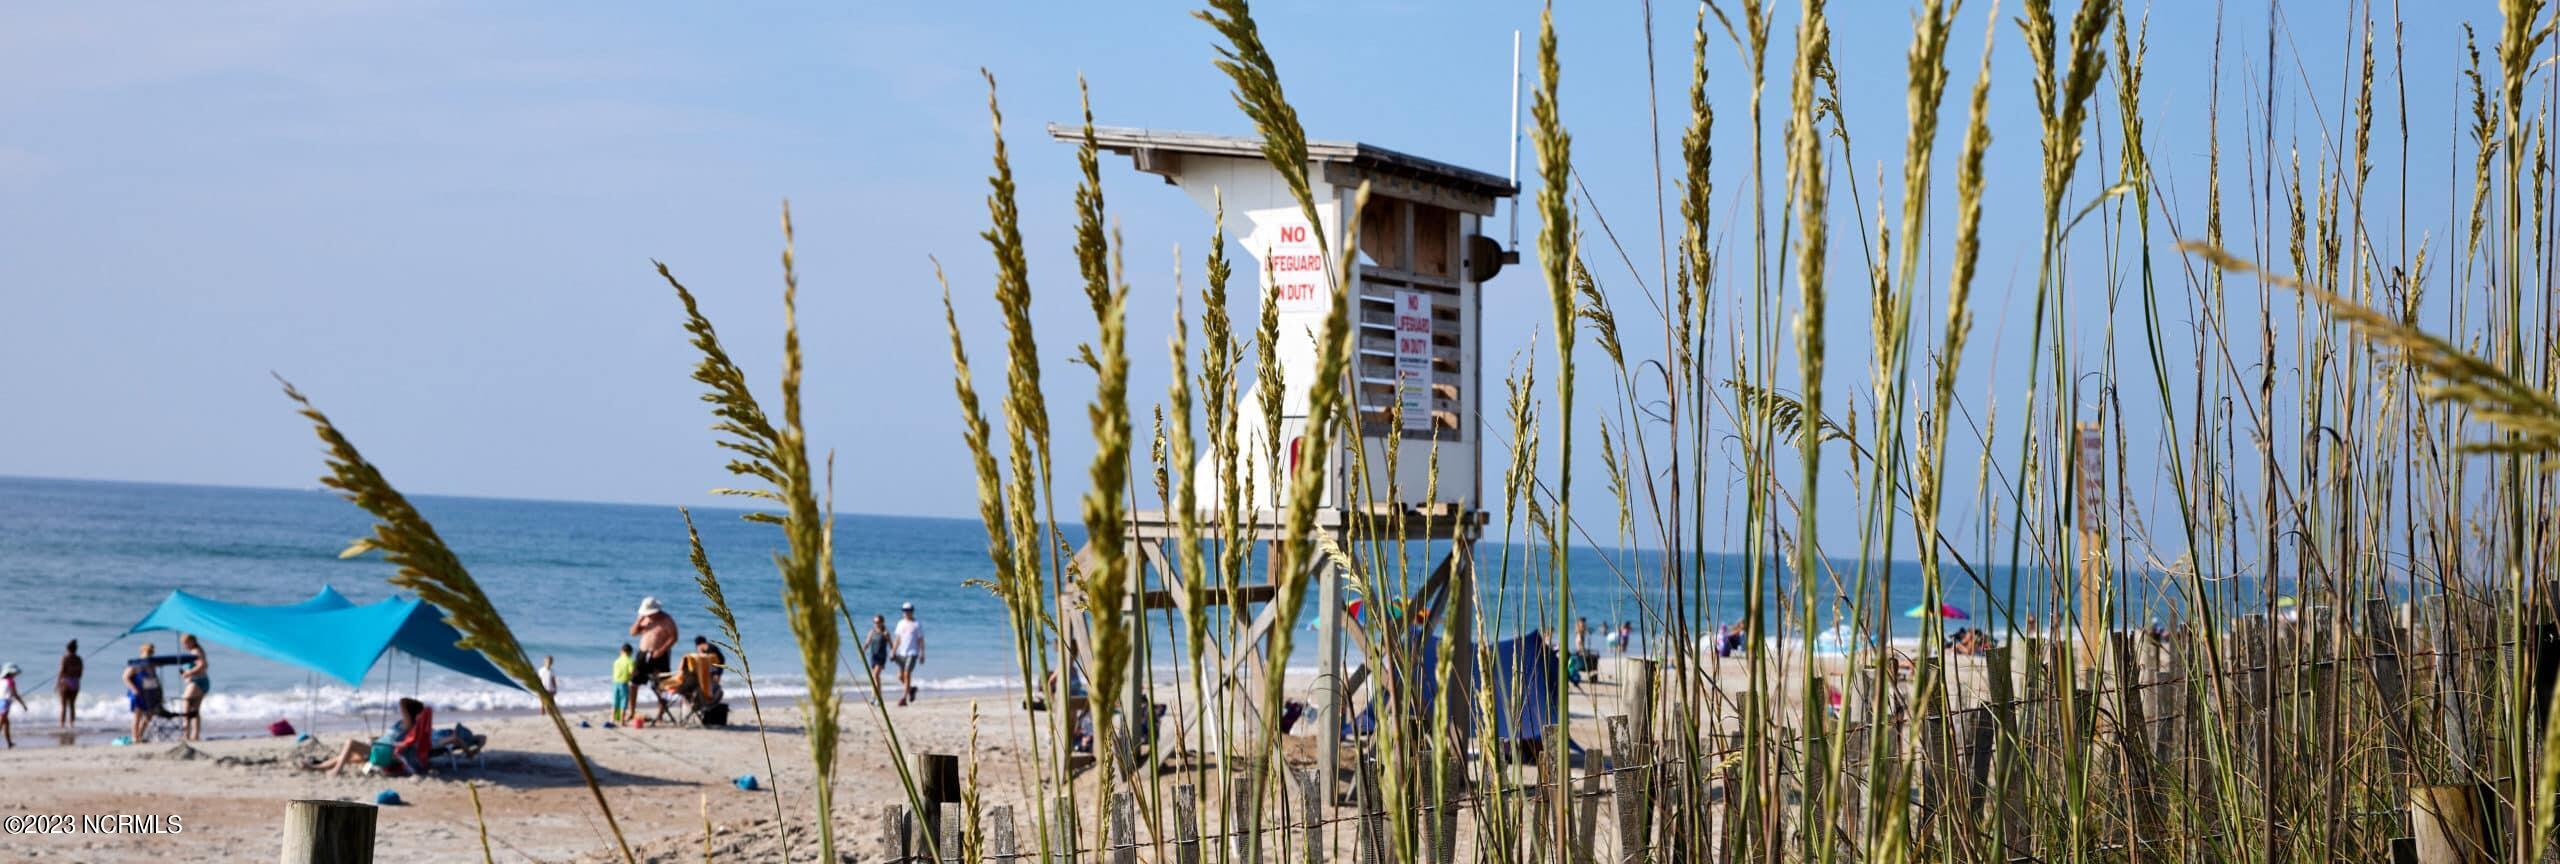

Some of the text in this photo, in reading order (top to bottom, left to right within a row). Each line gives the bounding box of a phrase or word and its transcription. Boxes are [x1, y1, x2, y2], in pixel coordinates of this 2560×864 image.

[1281, 226, 1305, 243] NO
[1287, 284, 1315, 300] DUTY
[1408, 294, 1419, 311] NO
[1397, 314, 1430, 334] LIFEGUARD
[1401, 337, 1427, 355] ON DUTY
